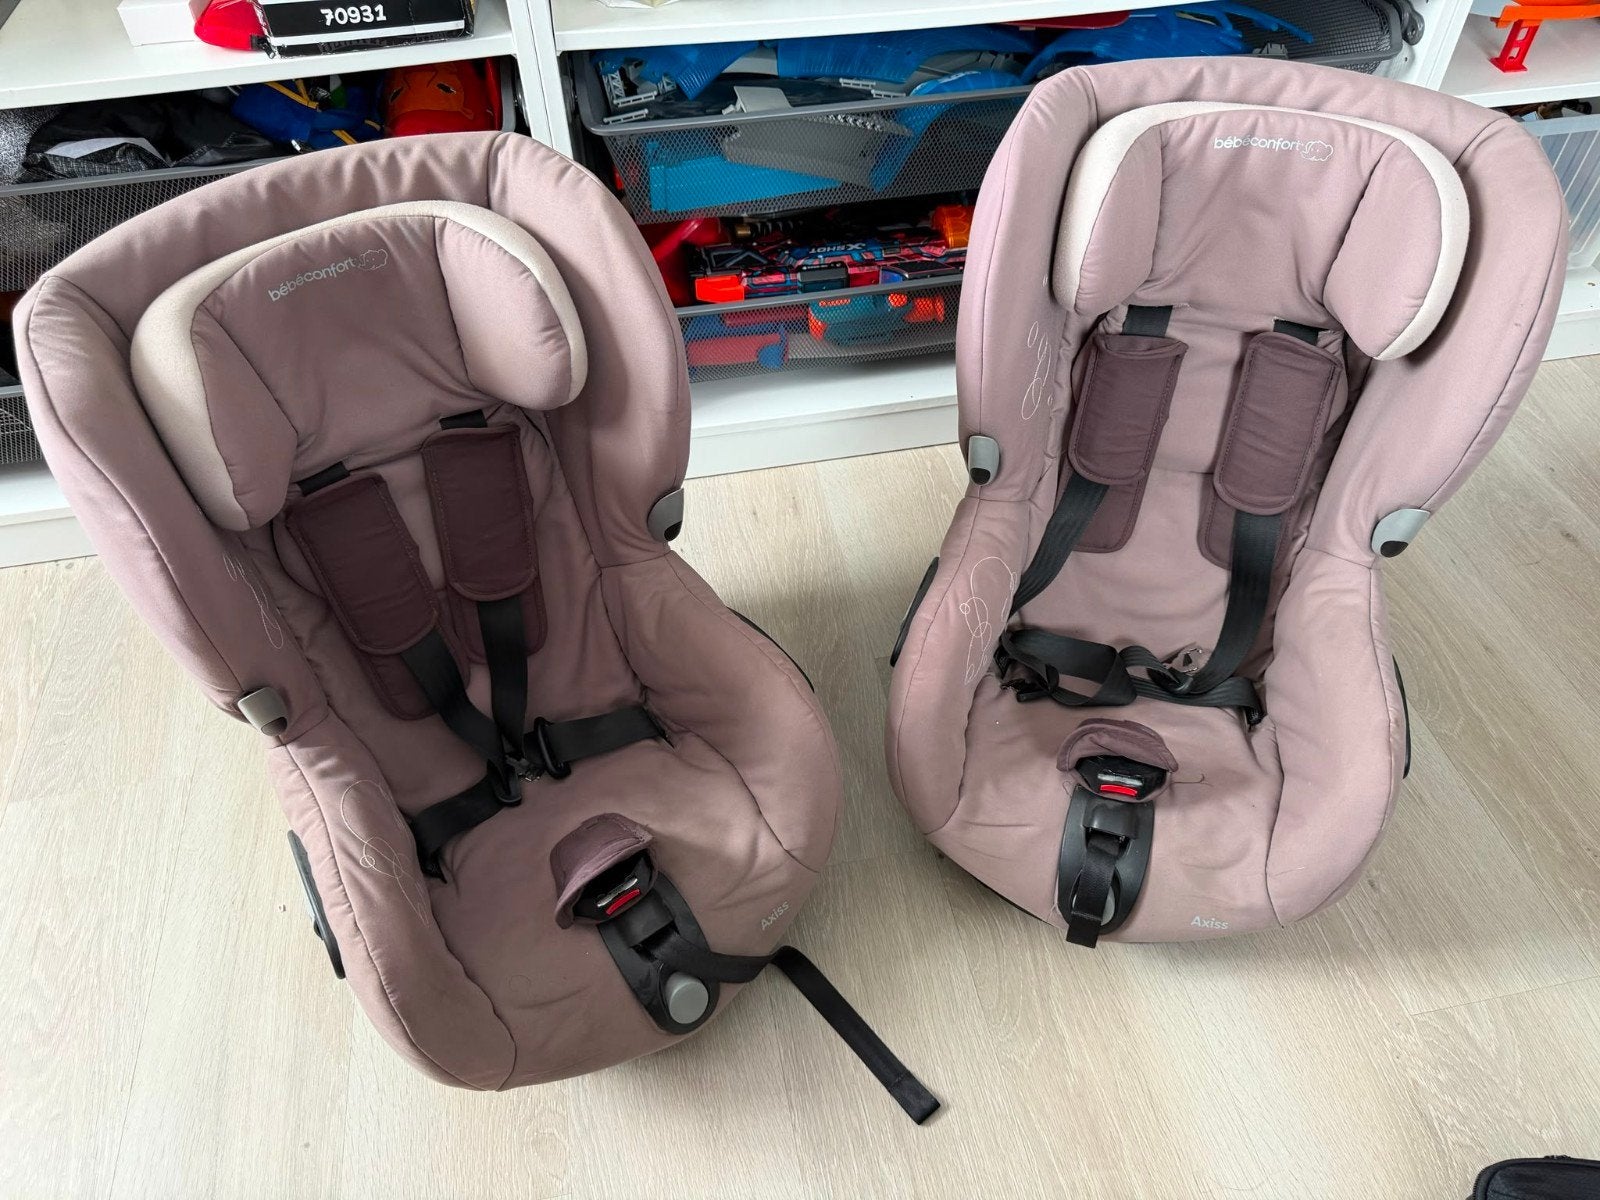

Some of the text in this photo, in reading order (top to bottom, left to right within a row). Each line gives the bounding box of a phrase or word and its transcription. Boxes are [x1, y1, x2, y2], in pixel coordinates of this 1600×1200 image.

[320, 4, 387, 26] 70931
[1213, 134, 1300, 151] bébéconfort
[268, 257, 355, 301] bébéconfort
[761, 901, 789, 931] Axiss
[1190, 916, 1229, 930] Axiss
